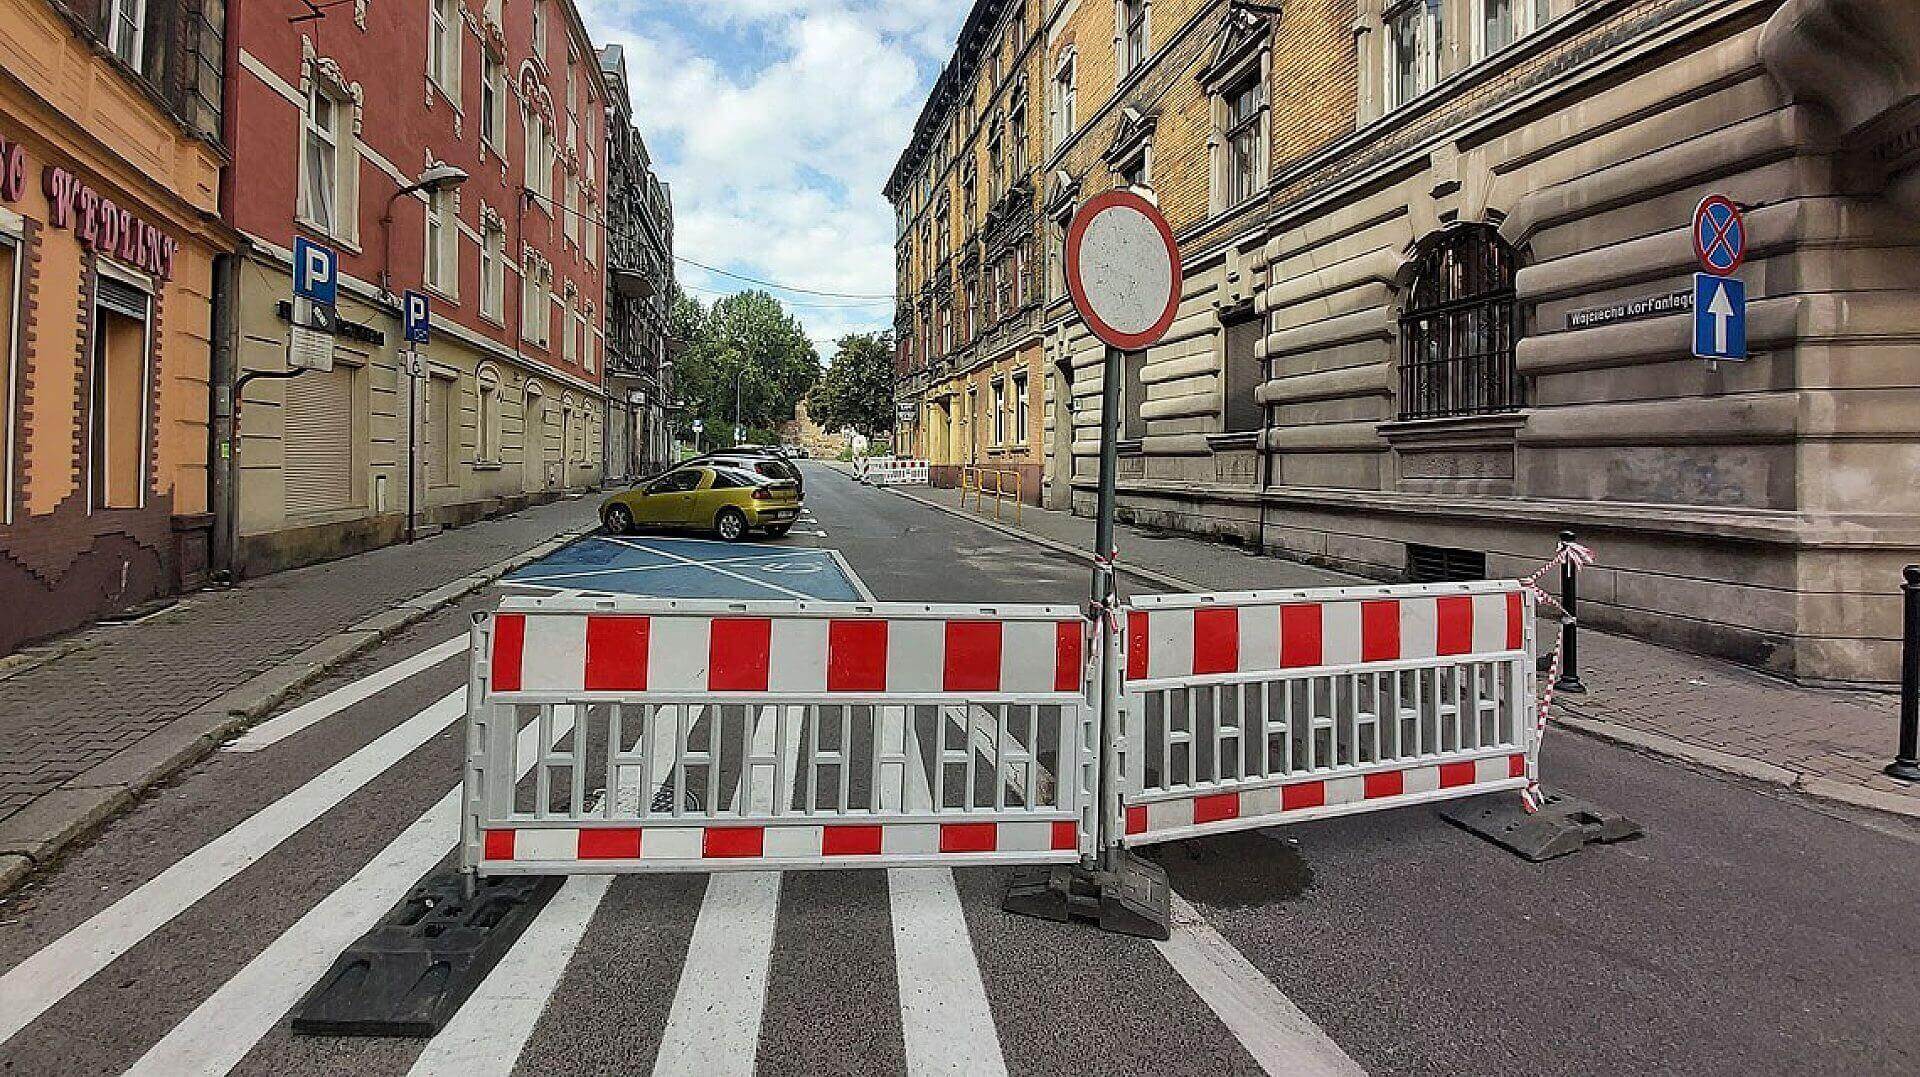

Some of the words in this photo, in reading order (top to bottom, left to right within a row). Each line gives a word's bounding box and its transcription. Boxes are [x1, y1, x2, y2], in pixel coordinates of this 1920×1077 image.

[304, 246, 330, 292] P
[410, 296, 426, 328] P
[1571, 305, 1626, 327] Wojciecha
